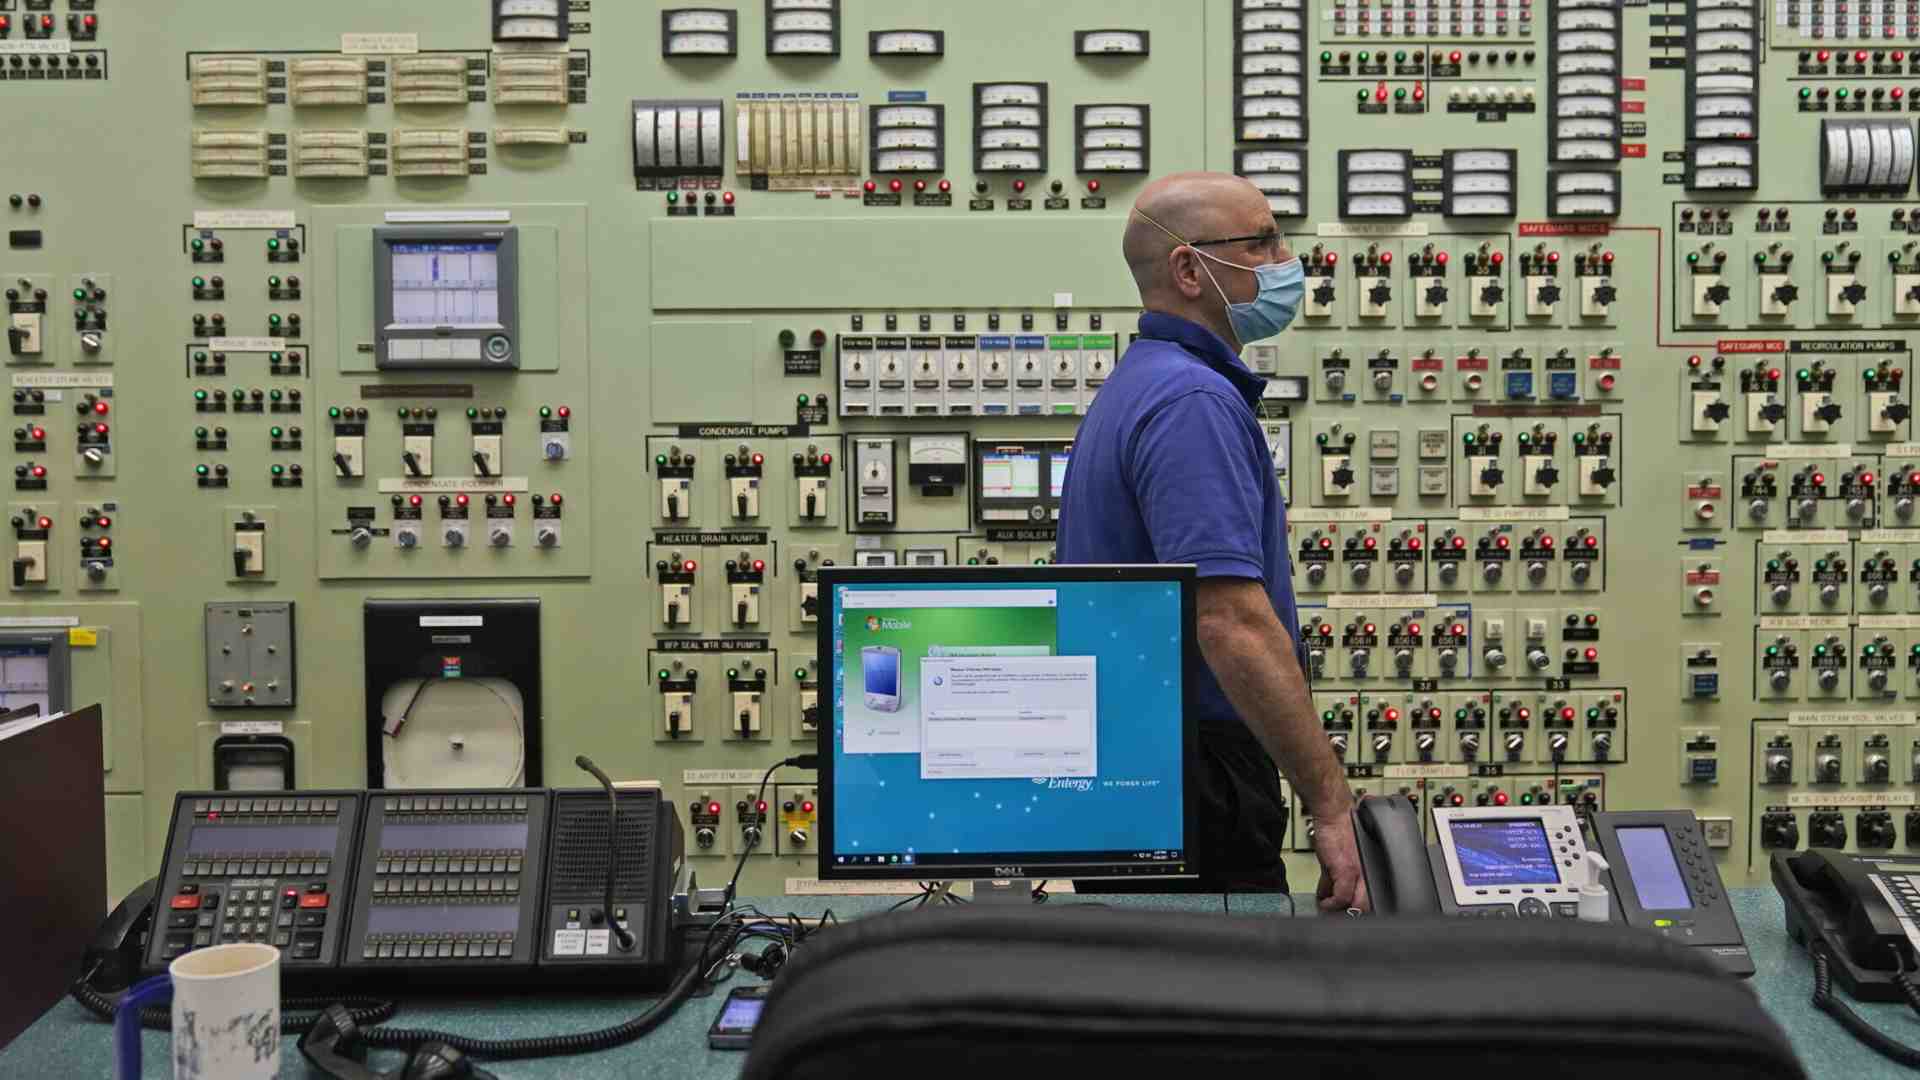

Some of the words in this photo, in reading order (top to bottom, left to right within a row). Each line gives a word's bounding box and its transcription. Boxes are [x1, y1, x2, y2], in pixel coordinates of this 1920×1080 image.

[1522, 223, 1574, 233] SAFEGUARD
[1721, 341, 1763, 351] SAFEGUARD
[1801, 341, 1864, 351] RECIRCULATION
[1867, 341, 1895, 351] PUMPS
[699, 426, 754, 437] CONDENSATE
[758, 426, 788, 437] PUMPS
[662, 534, 697, 543] HEATER
[700, 534, 727, 543] DRAIN
[730, 534, 760, 543] PUMPS
[997, 530, 1015, 539] AUX
[681, 640, 700, 649] SEAL
[703, 640, 719, 649] WTR
[736, 640, 761, 649] PUMPS
[1048, 777, 1092, 791] Entergy
[994, 867, 1024, 876] DELL
